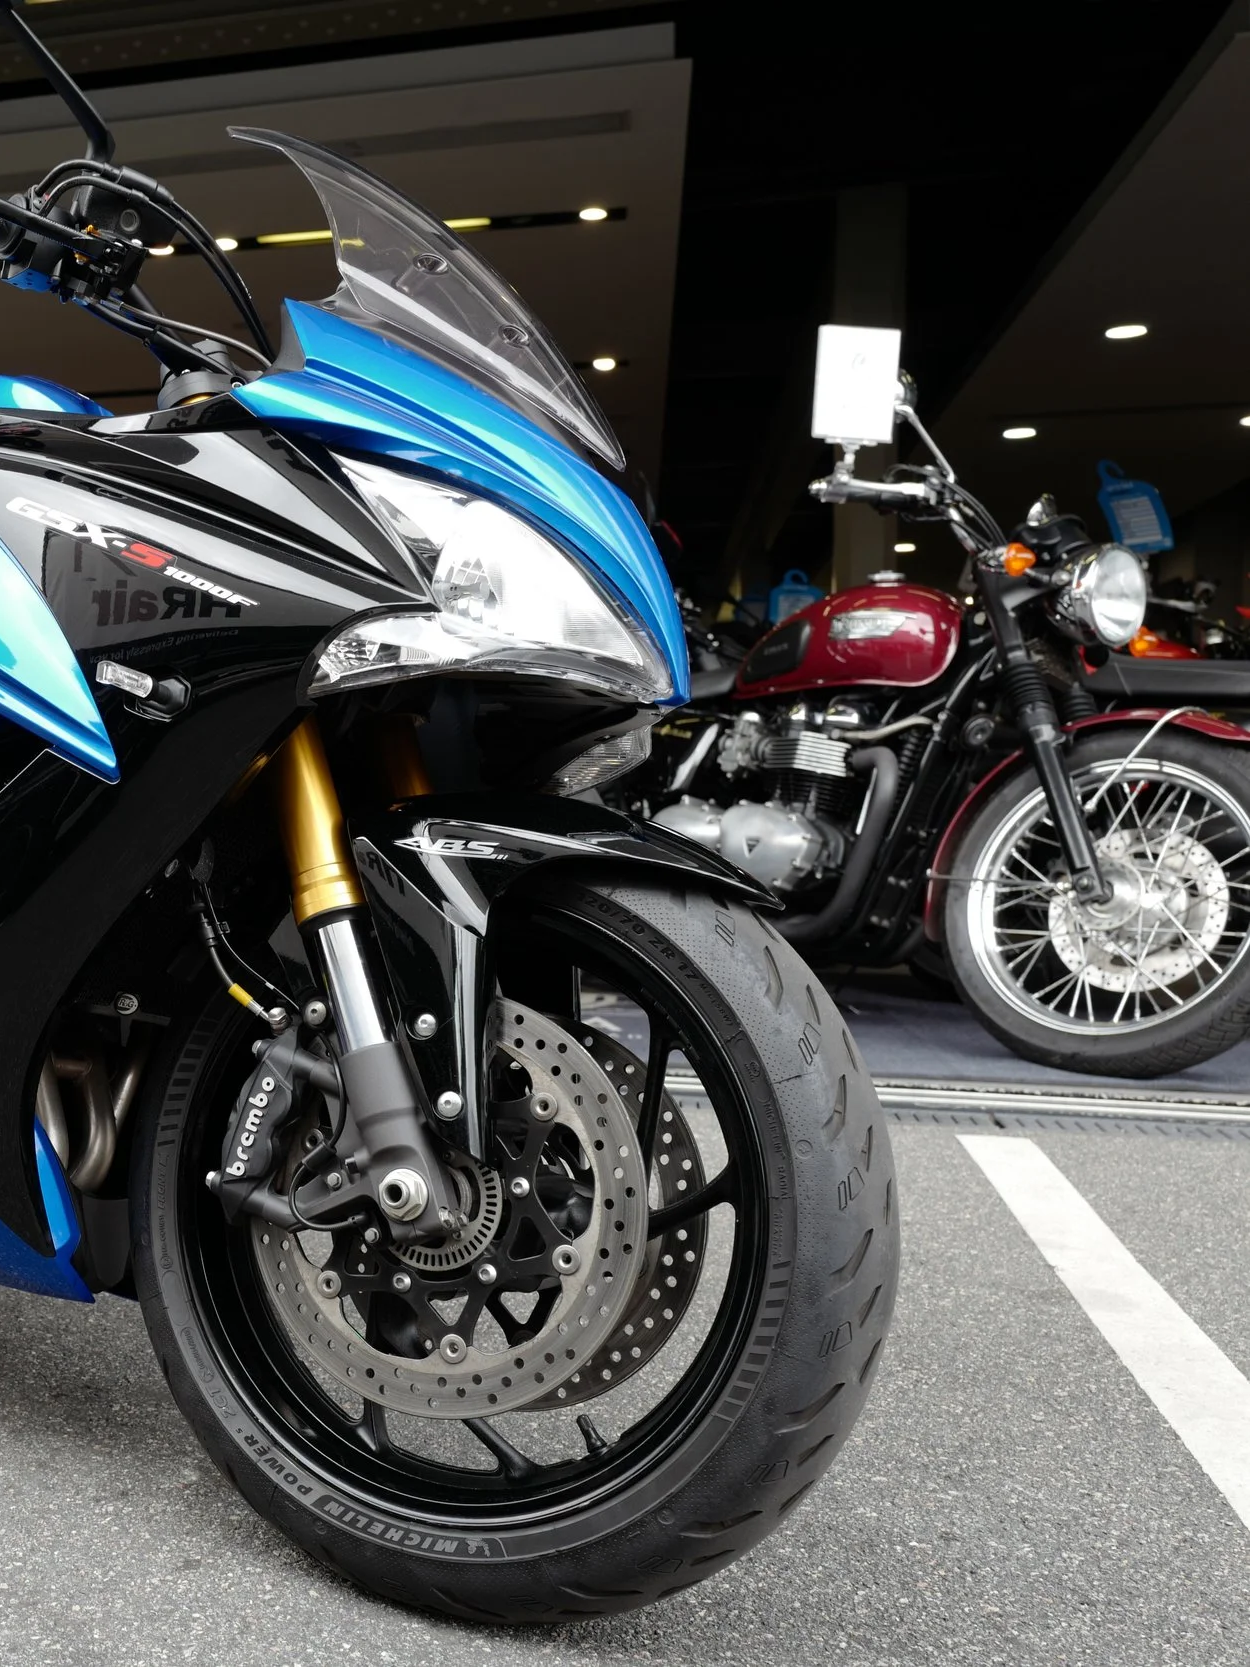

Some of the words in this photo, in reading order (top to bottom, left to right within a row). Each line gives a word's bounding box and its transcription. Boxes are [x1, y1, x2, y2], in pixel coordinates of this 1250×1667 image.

[393, 835, 508, 861] ABS
[225, 1076, 276, 1177] brembo
[243, 1433, 314, 1496] POWER
[323, 1502, 460, 1553] MICHELIN
